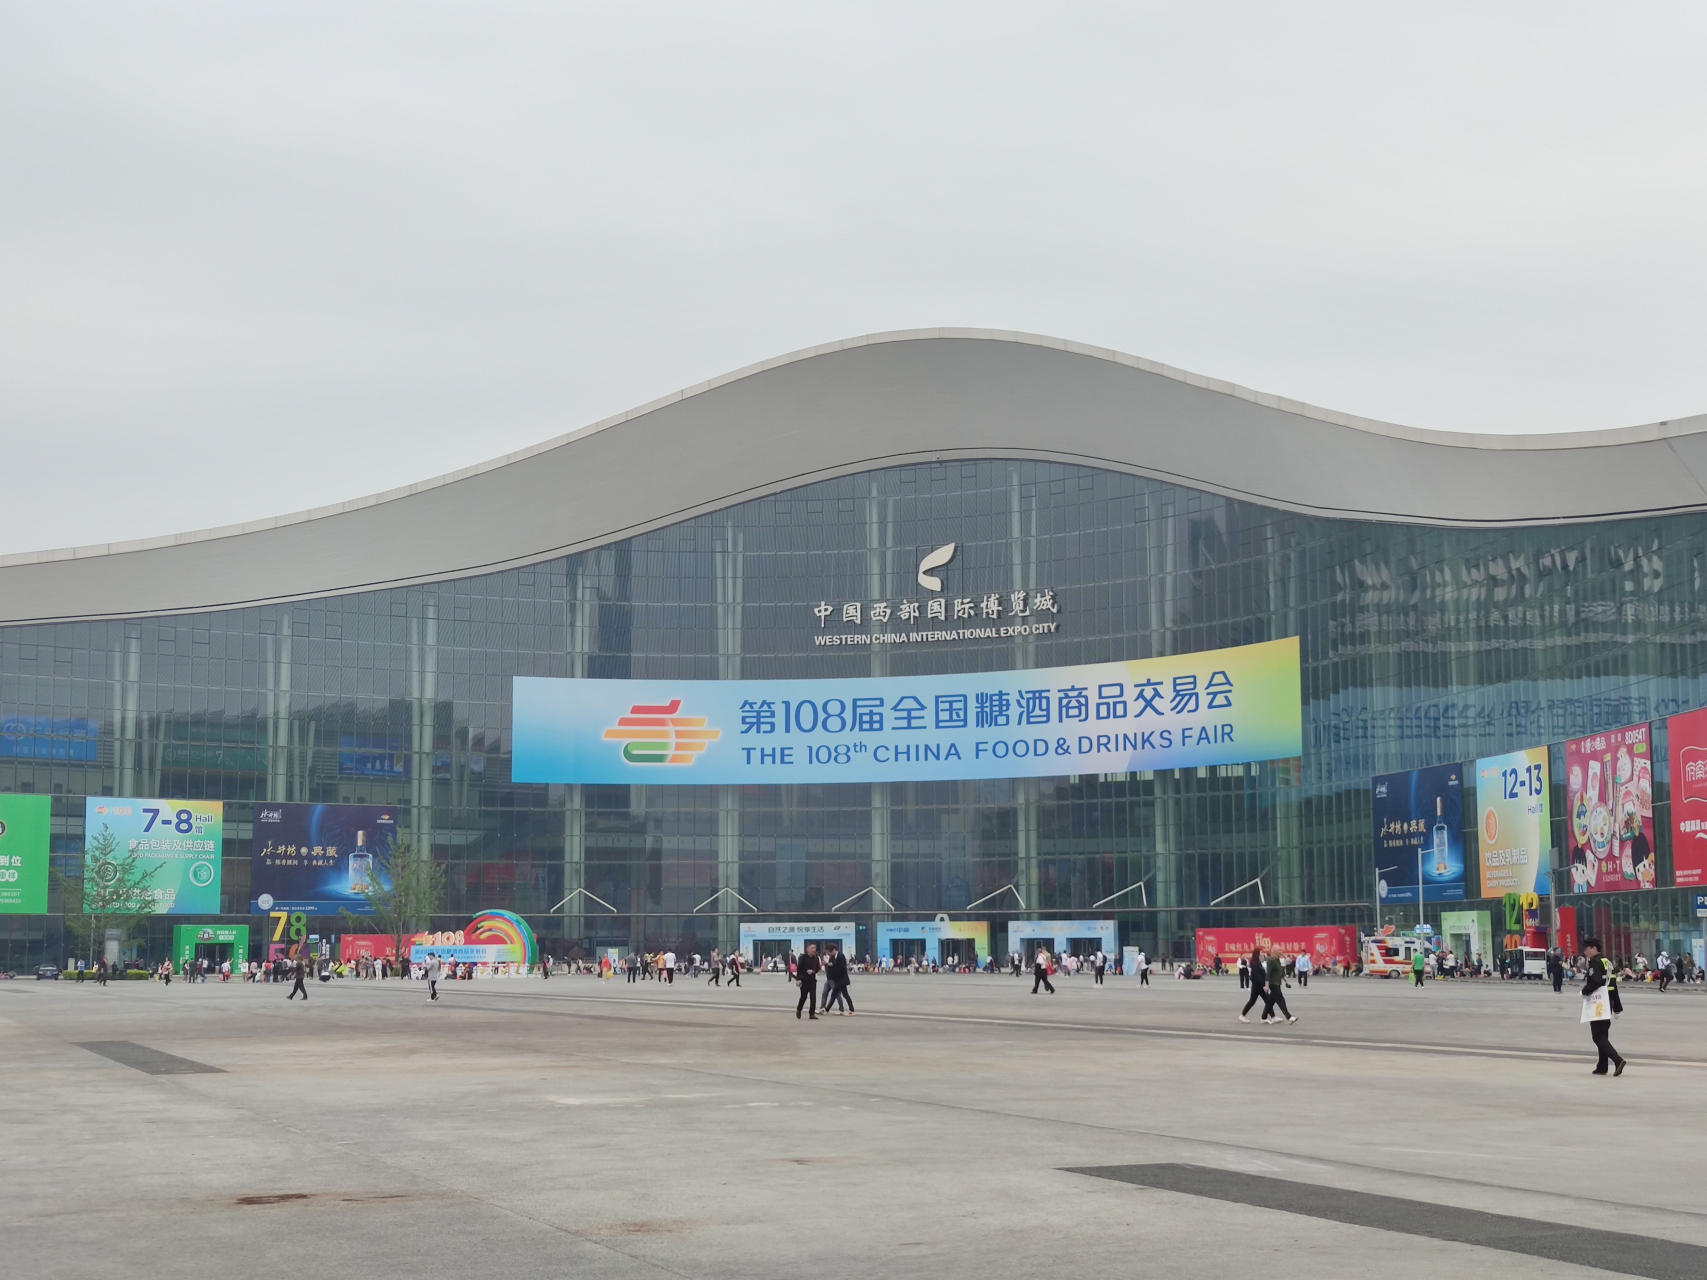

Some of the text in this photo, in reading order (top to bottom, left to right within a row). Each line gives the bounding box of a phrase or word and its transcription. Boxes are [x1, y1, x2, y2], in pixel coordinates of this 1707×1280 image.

[813, 590, 1058, 628] 中国西部国际博览城
[814, 622, 1057, 646] WESTERN CHINA INTERNATIONAL EXPO CITY
[739, 670, 1234, 735] 第108届全国糖酒商品交易会
[741, 746, 794, 765] THE
[806, 741, 867, 765] 108th
[873, 742, 962, 763] CHINA
[1181, 723, 1235, 746] FAIR
[1502, 763, 1543, 800] 12-13
[142, 808, 213, 834] 7-8 Hall
[1527, 804, 1539, 815] Hall
[128, 838, 215, 852] 食品包装及供应链
[1503, 892, 1521, 931] 12
[434, 930, 465, 946] 108
